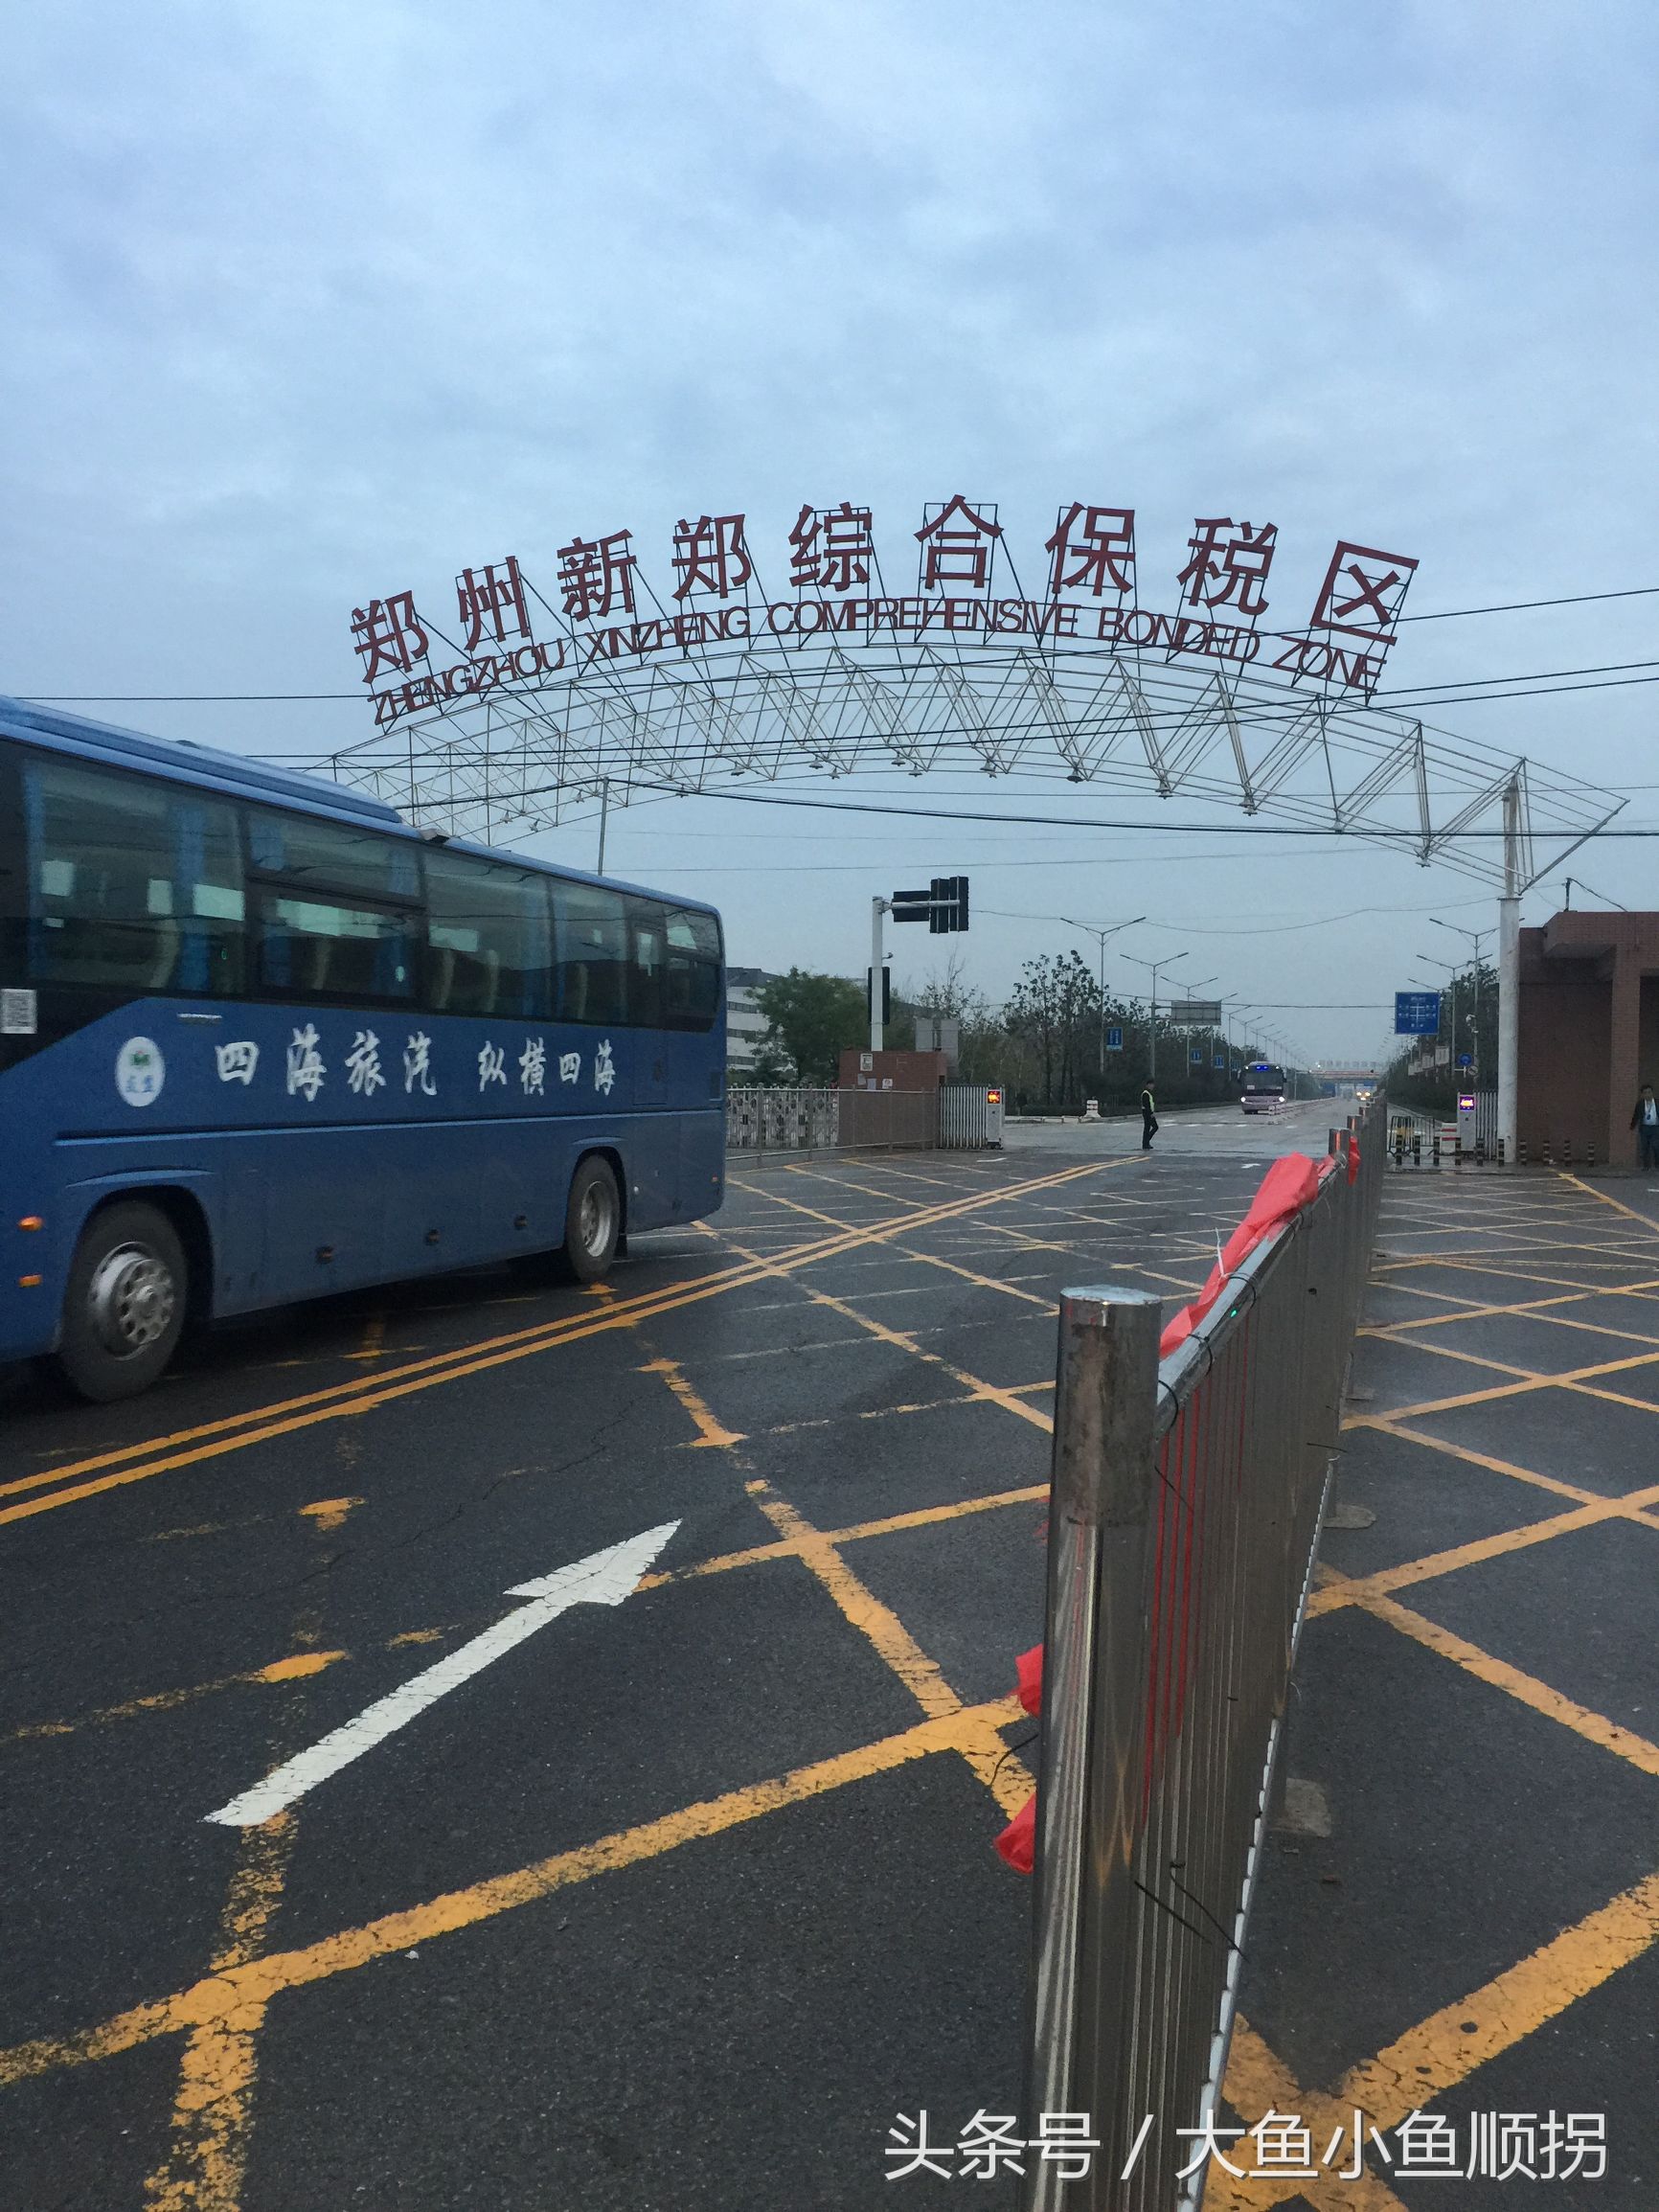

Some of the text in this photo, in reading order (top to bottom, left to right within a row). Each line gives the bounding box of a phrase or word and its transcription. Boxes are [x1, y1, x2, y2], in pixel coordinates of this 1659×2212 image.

[351, 494, 1420, 683] 郑州新郑综合保税区
[367, 599, 1387, 726] ZHENGZHOU XINZHENG COMPREHENSIVE BONDED ZONE
[215, 1023, 616, 1102] 四海旅汽 纵横四海
